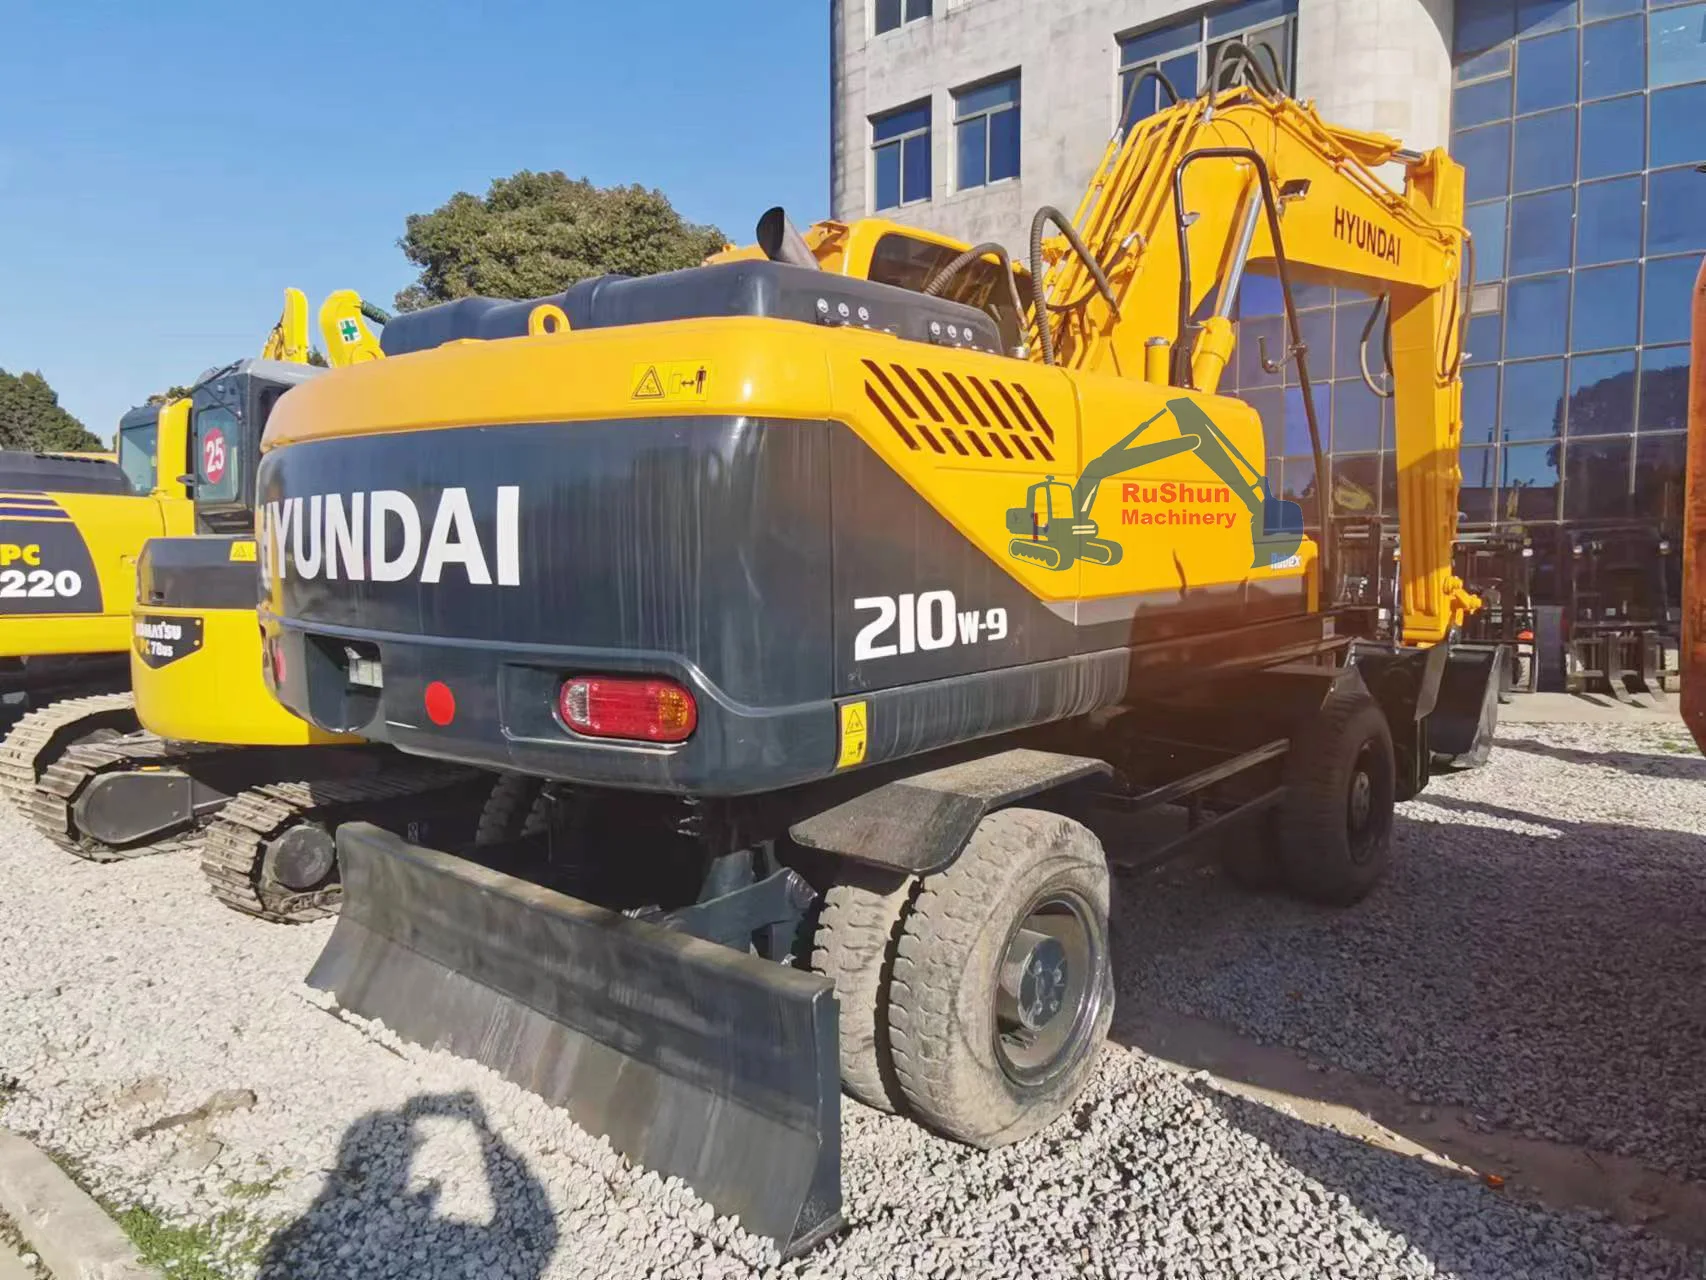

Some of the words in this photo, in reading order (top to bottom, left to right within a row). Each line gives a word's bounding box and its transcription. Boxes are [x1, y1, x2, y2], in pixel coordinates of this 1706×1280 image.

[1334, 205, 1401, 266] HYUNDAI
[206, 436, 225, 473] 25
[258, 486, 520, 586] HYUNDAI
[0, 543, 41, 567] PC
[0, 569, 82, 597] 220
